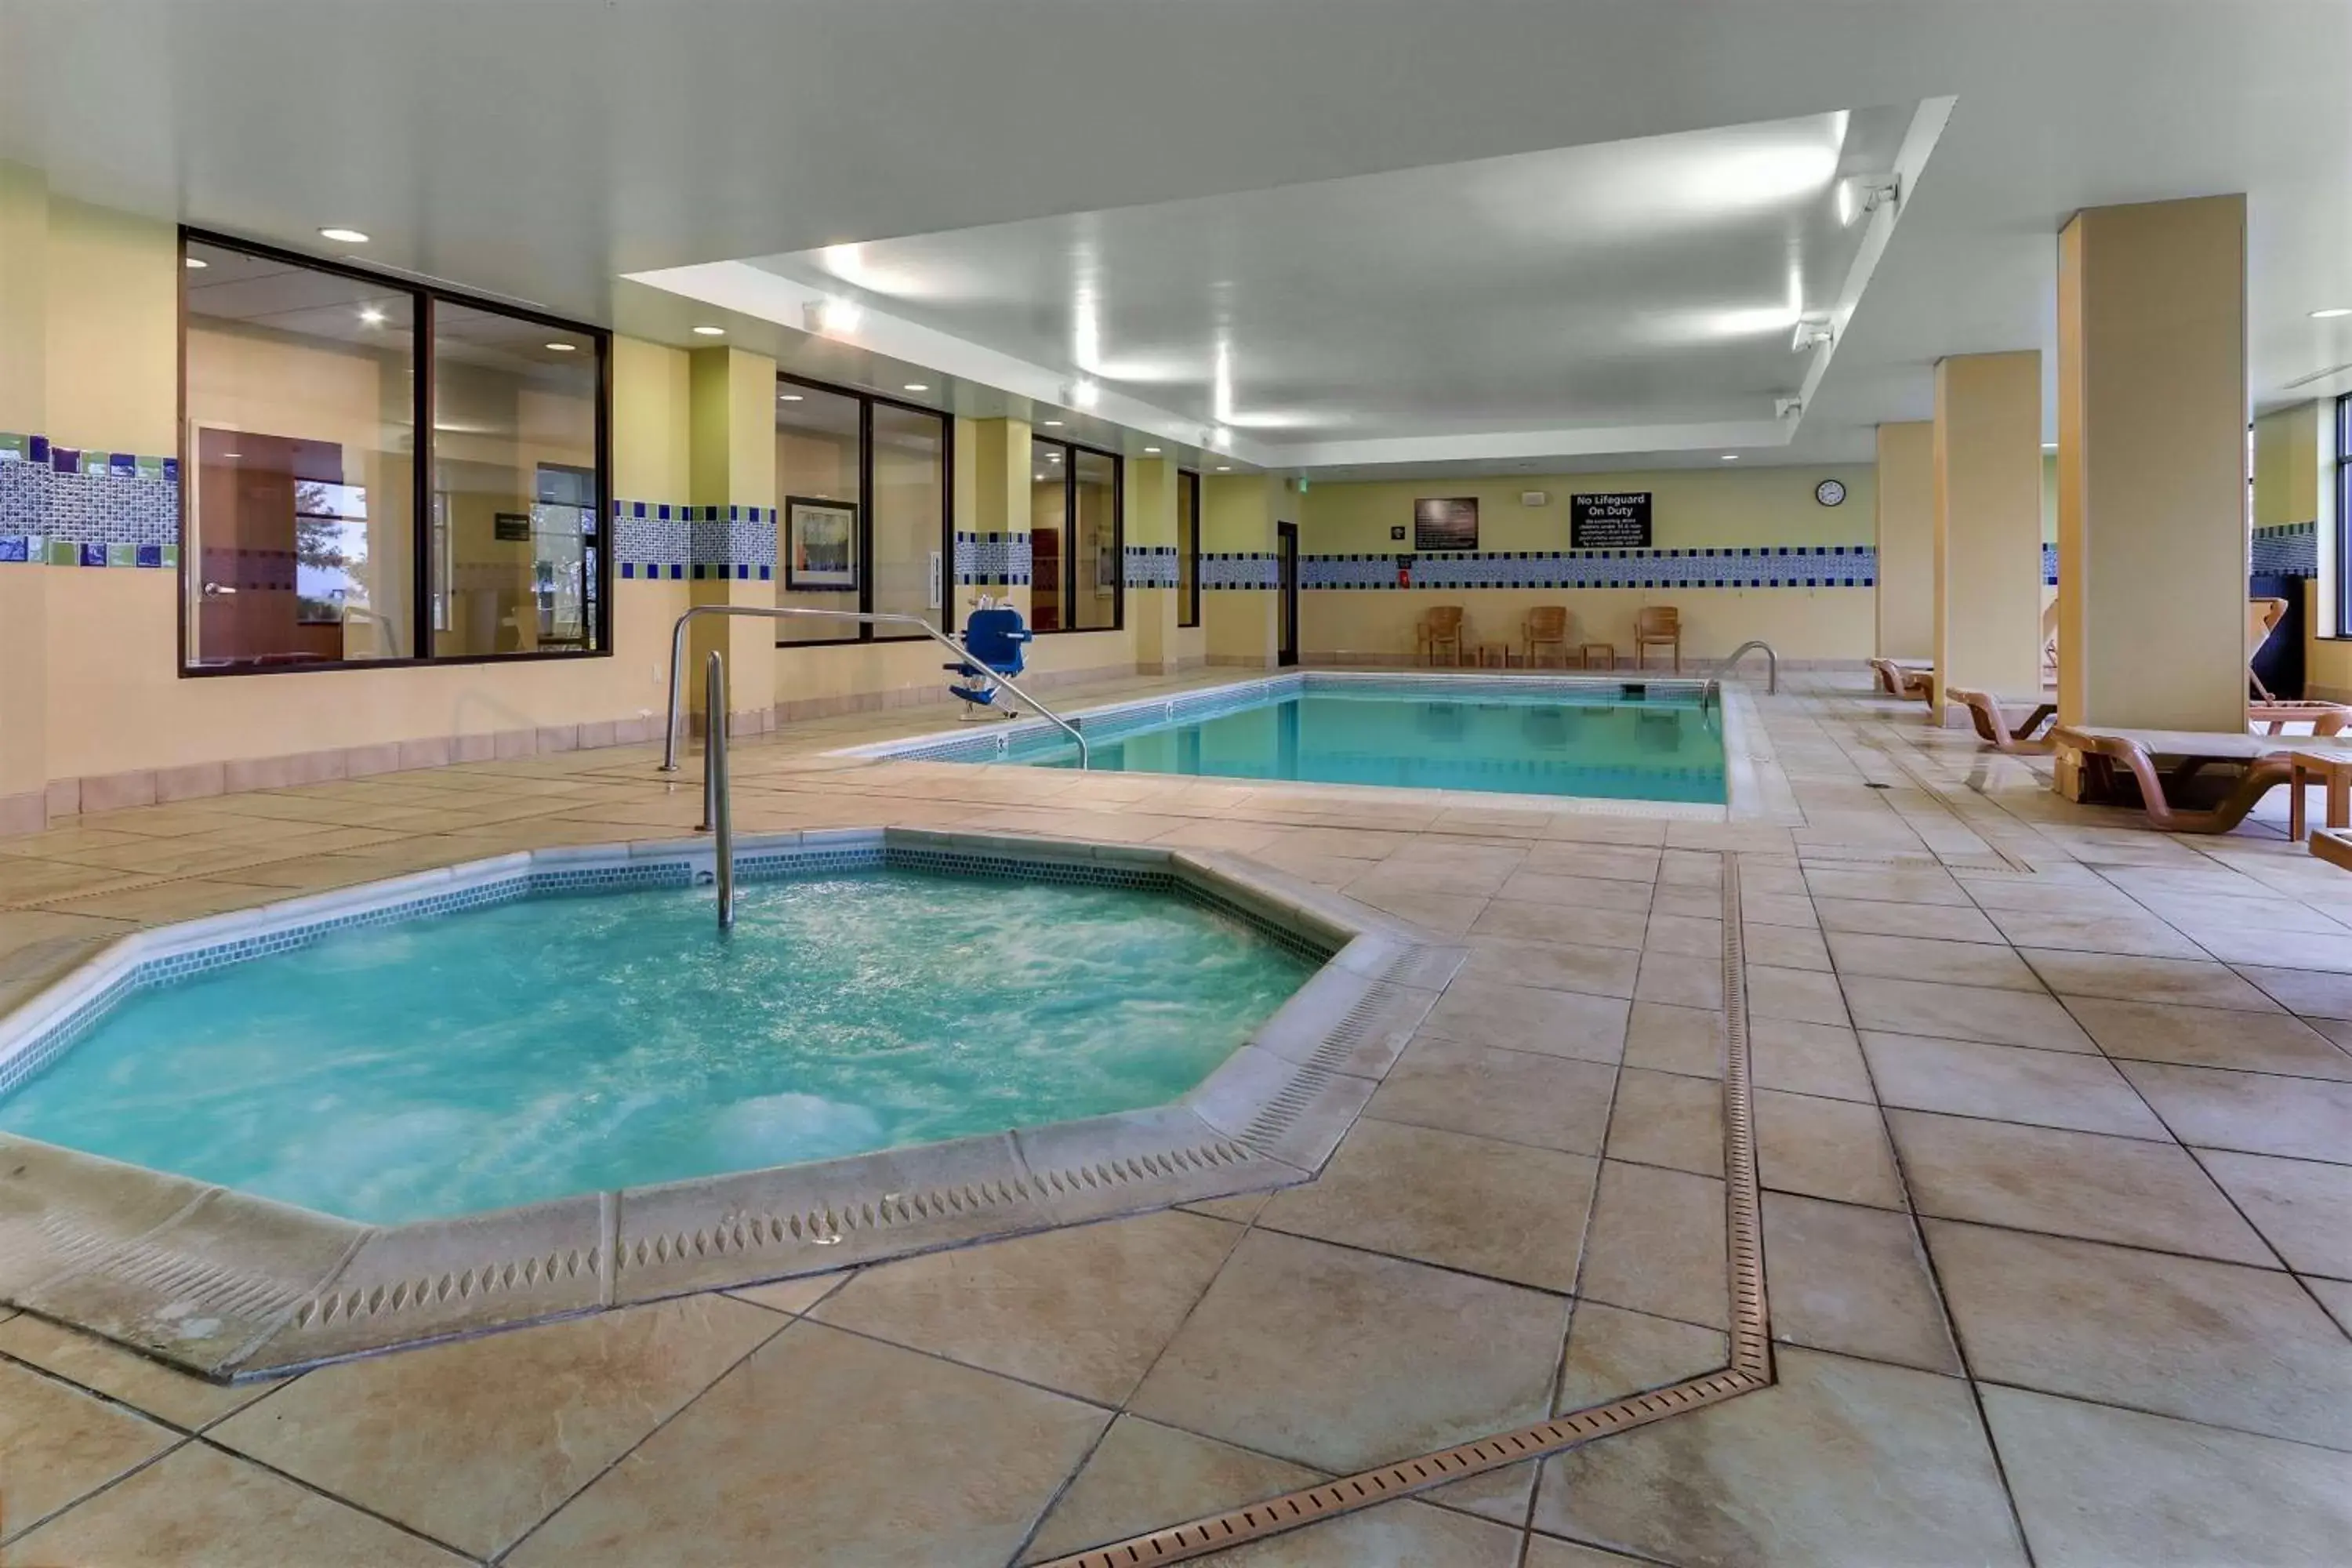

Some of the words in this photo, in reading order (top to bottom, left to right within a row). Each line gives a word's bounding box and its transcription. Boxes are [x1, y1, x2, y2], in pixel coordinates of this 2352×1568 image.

[1577, 496, 1592, 505] No
[1595, 494, 1645, 506] Lifeguard
[1588, 506, 1605, 515] On
[1607, 506, 1633, 517] Duty
